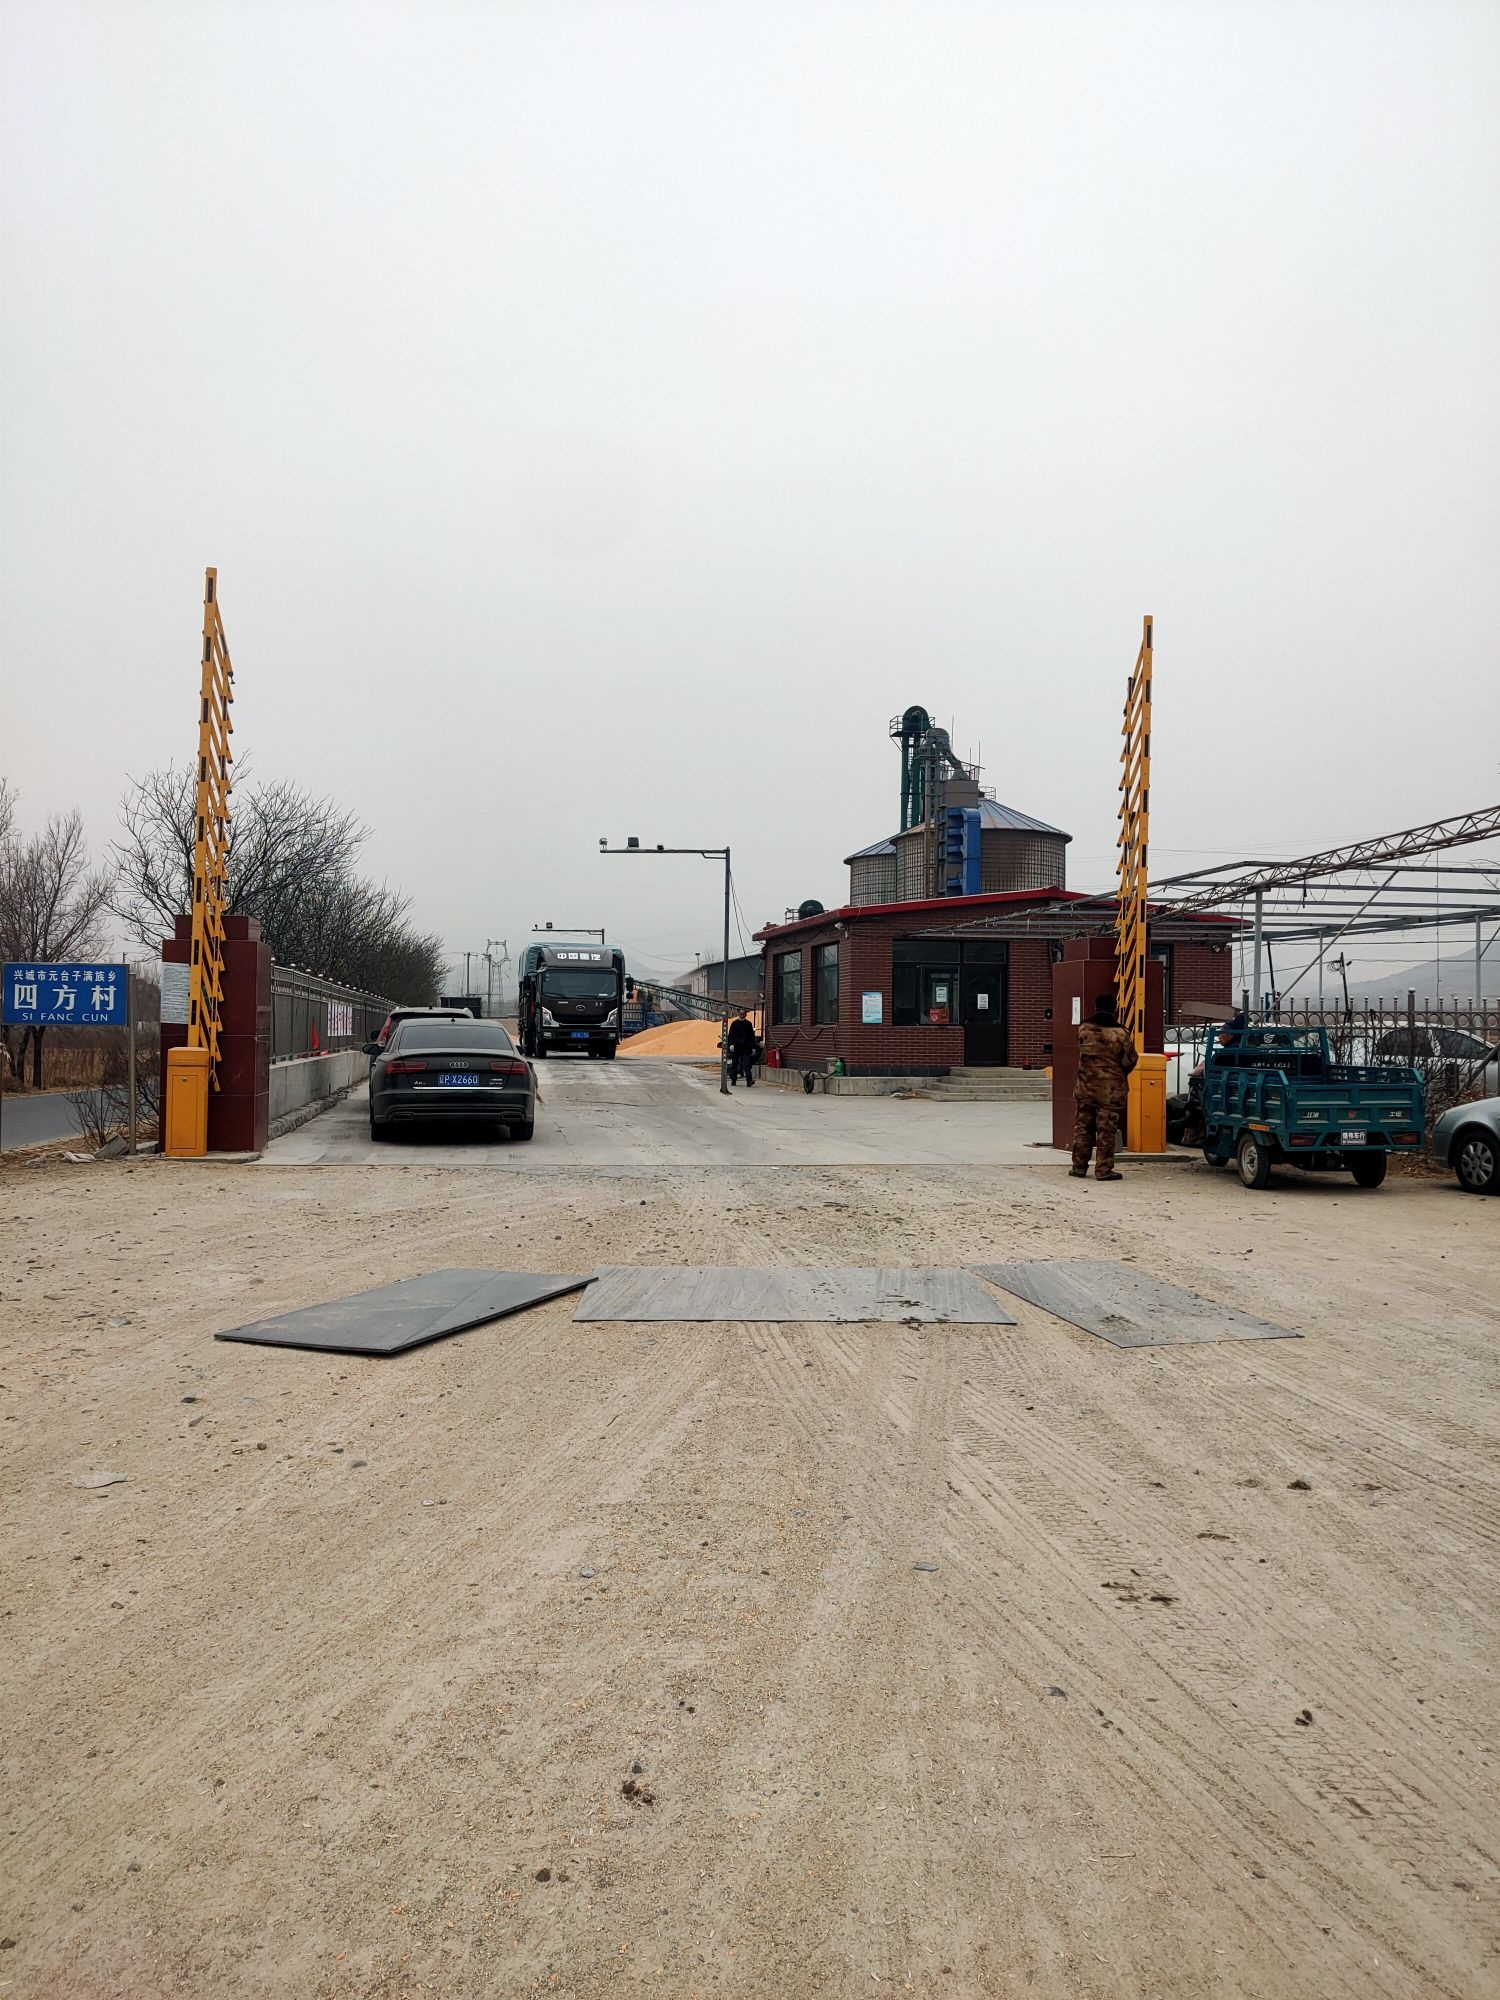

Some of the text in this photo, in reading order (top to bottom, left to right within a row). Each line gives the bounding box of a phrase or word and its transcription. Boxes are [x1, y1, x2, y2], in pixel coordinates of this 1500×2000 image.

[14, 970, 116, 982] 兴城市元台子满族乡
[14, 984, 117, 1011] 四方村
[22, 1012, 33, 1021] SI
[81, 1013, 108, 1022] CUN
